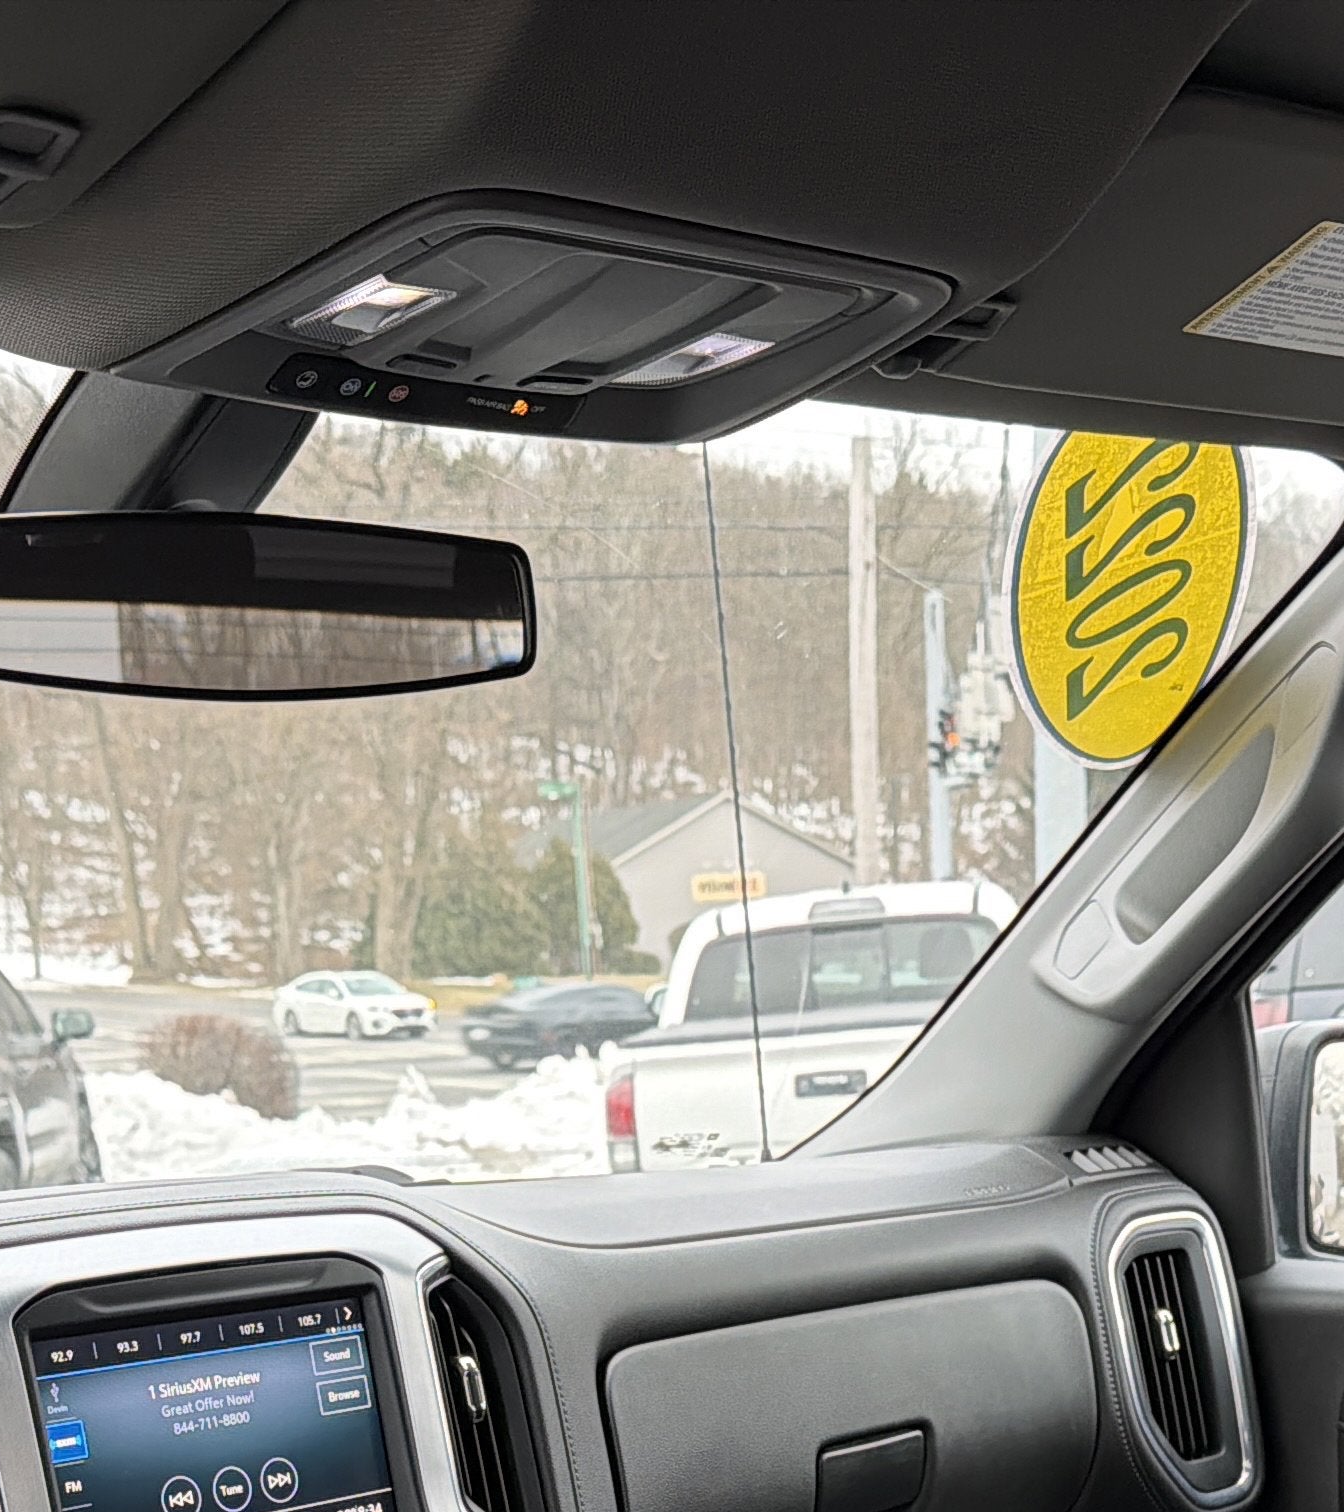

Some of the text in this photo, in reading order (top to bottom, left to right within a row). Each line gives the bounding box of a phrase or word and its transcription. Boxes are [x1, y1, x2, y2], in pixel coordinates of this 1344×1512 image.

[297, 1313, 322, 1327] 105.7
[238, 1321, 265, 1336] 107.5
[180, 1330, 201, 1345] 97.7
[116, 1340, 139, 1354] 93.3
[50, 1349, 74, 1363] 92.9
[323, 1348, 351, 1362] Sound
[148, 1370, 261, 1399] 1 SiriusXM Preview
[327, 1388, 361, 1402] Browse
[161, 1389, 256, 1418] Great Offer Now!
[173, 1410, 251, 1436] 844-711-8800
[64, 1480, 82, 1493] FM
[219, 1483, 244, 1497] Tune
